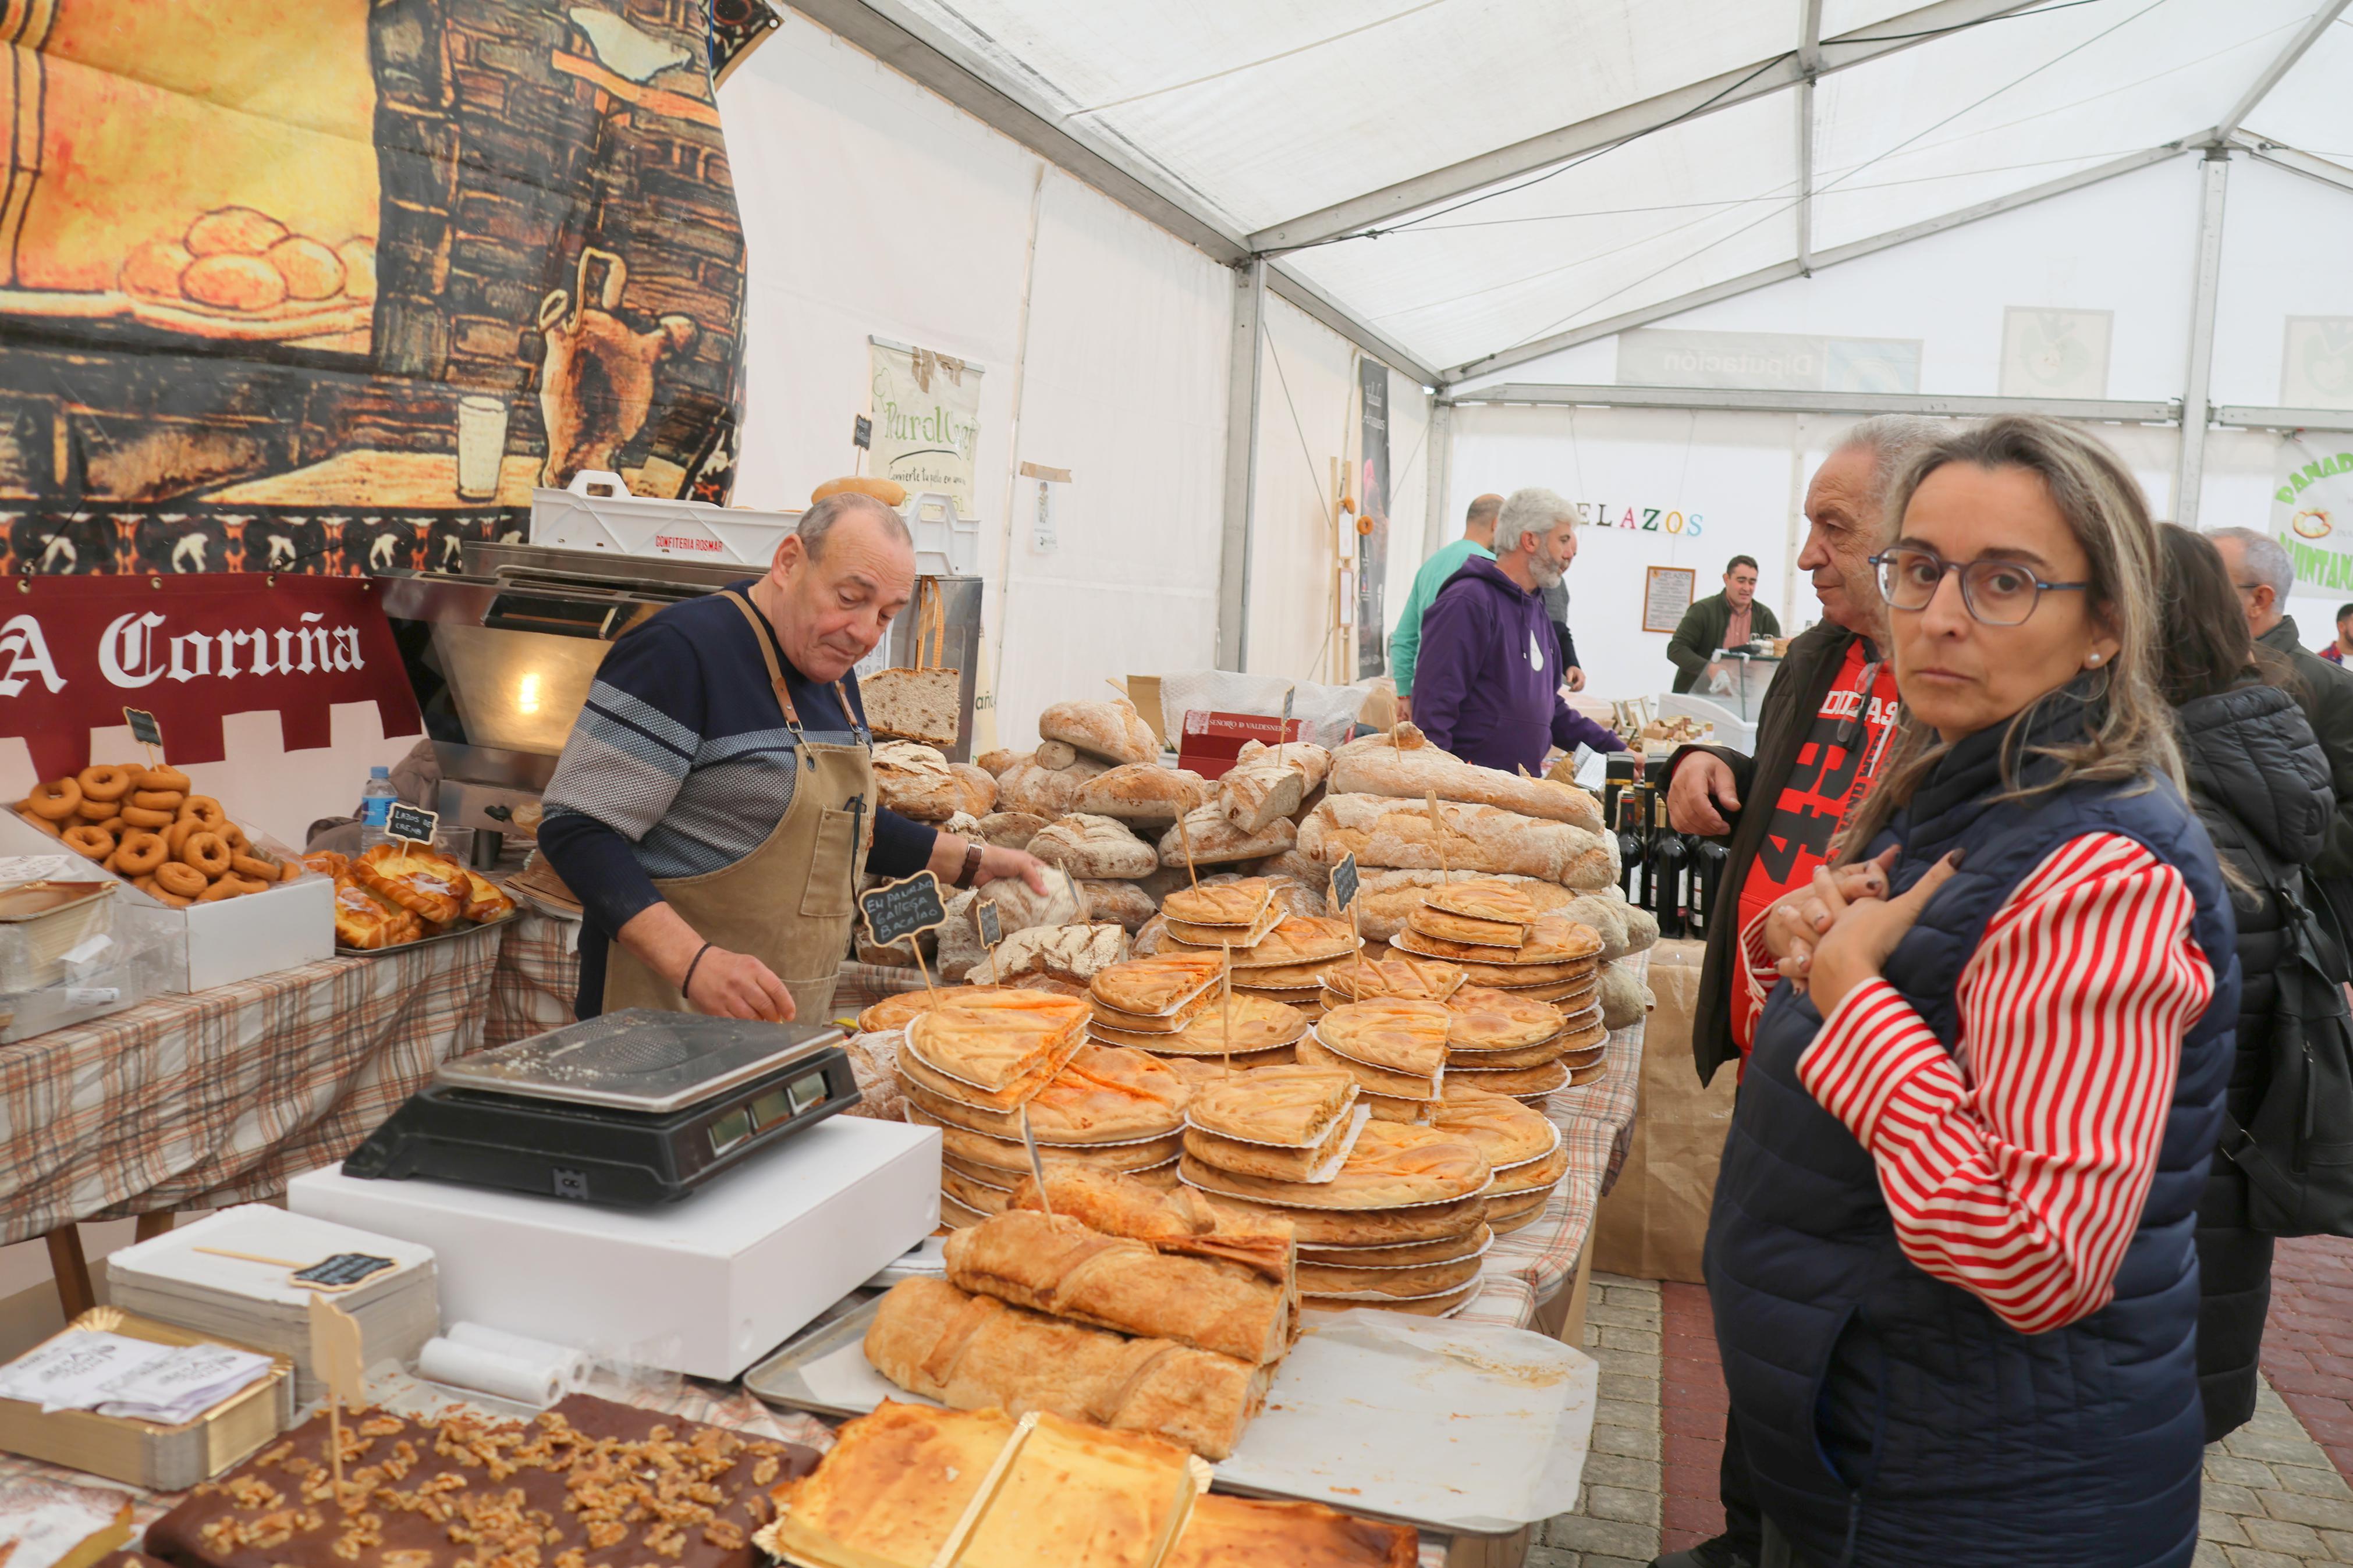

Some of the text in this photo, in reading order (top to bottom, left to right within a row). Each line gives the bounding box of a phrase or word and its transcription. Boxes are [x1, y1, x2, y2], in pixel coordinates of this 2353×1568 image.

[695, 539, 723, 552] ROSMAR
[0, 611, 365, 697] A Coruña
